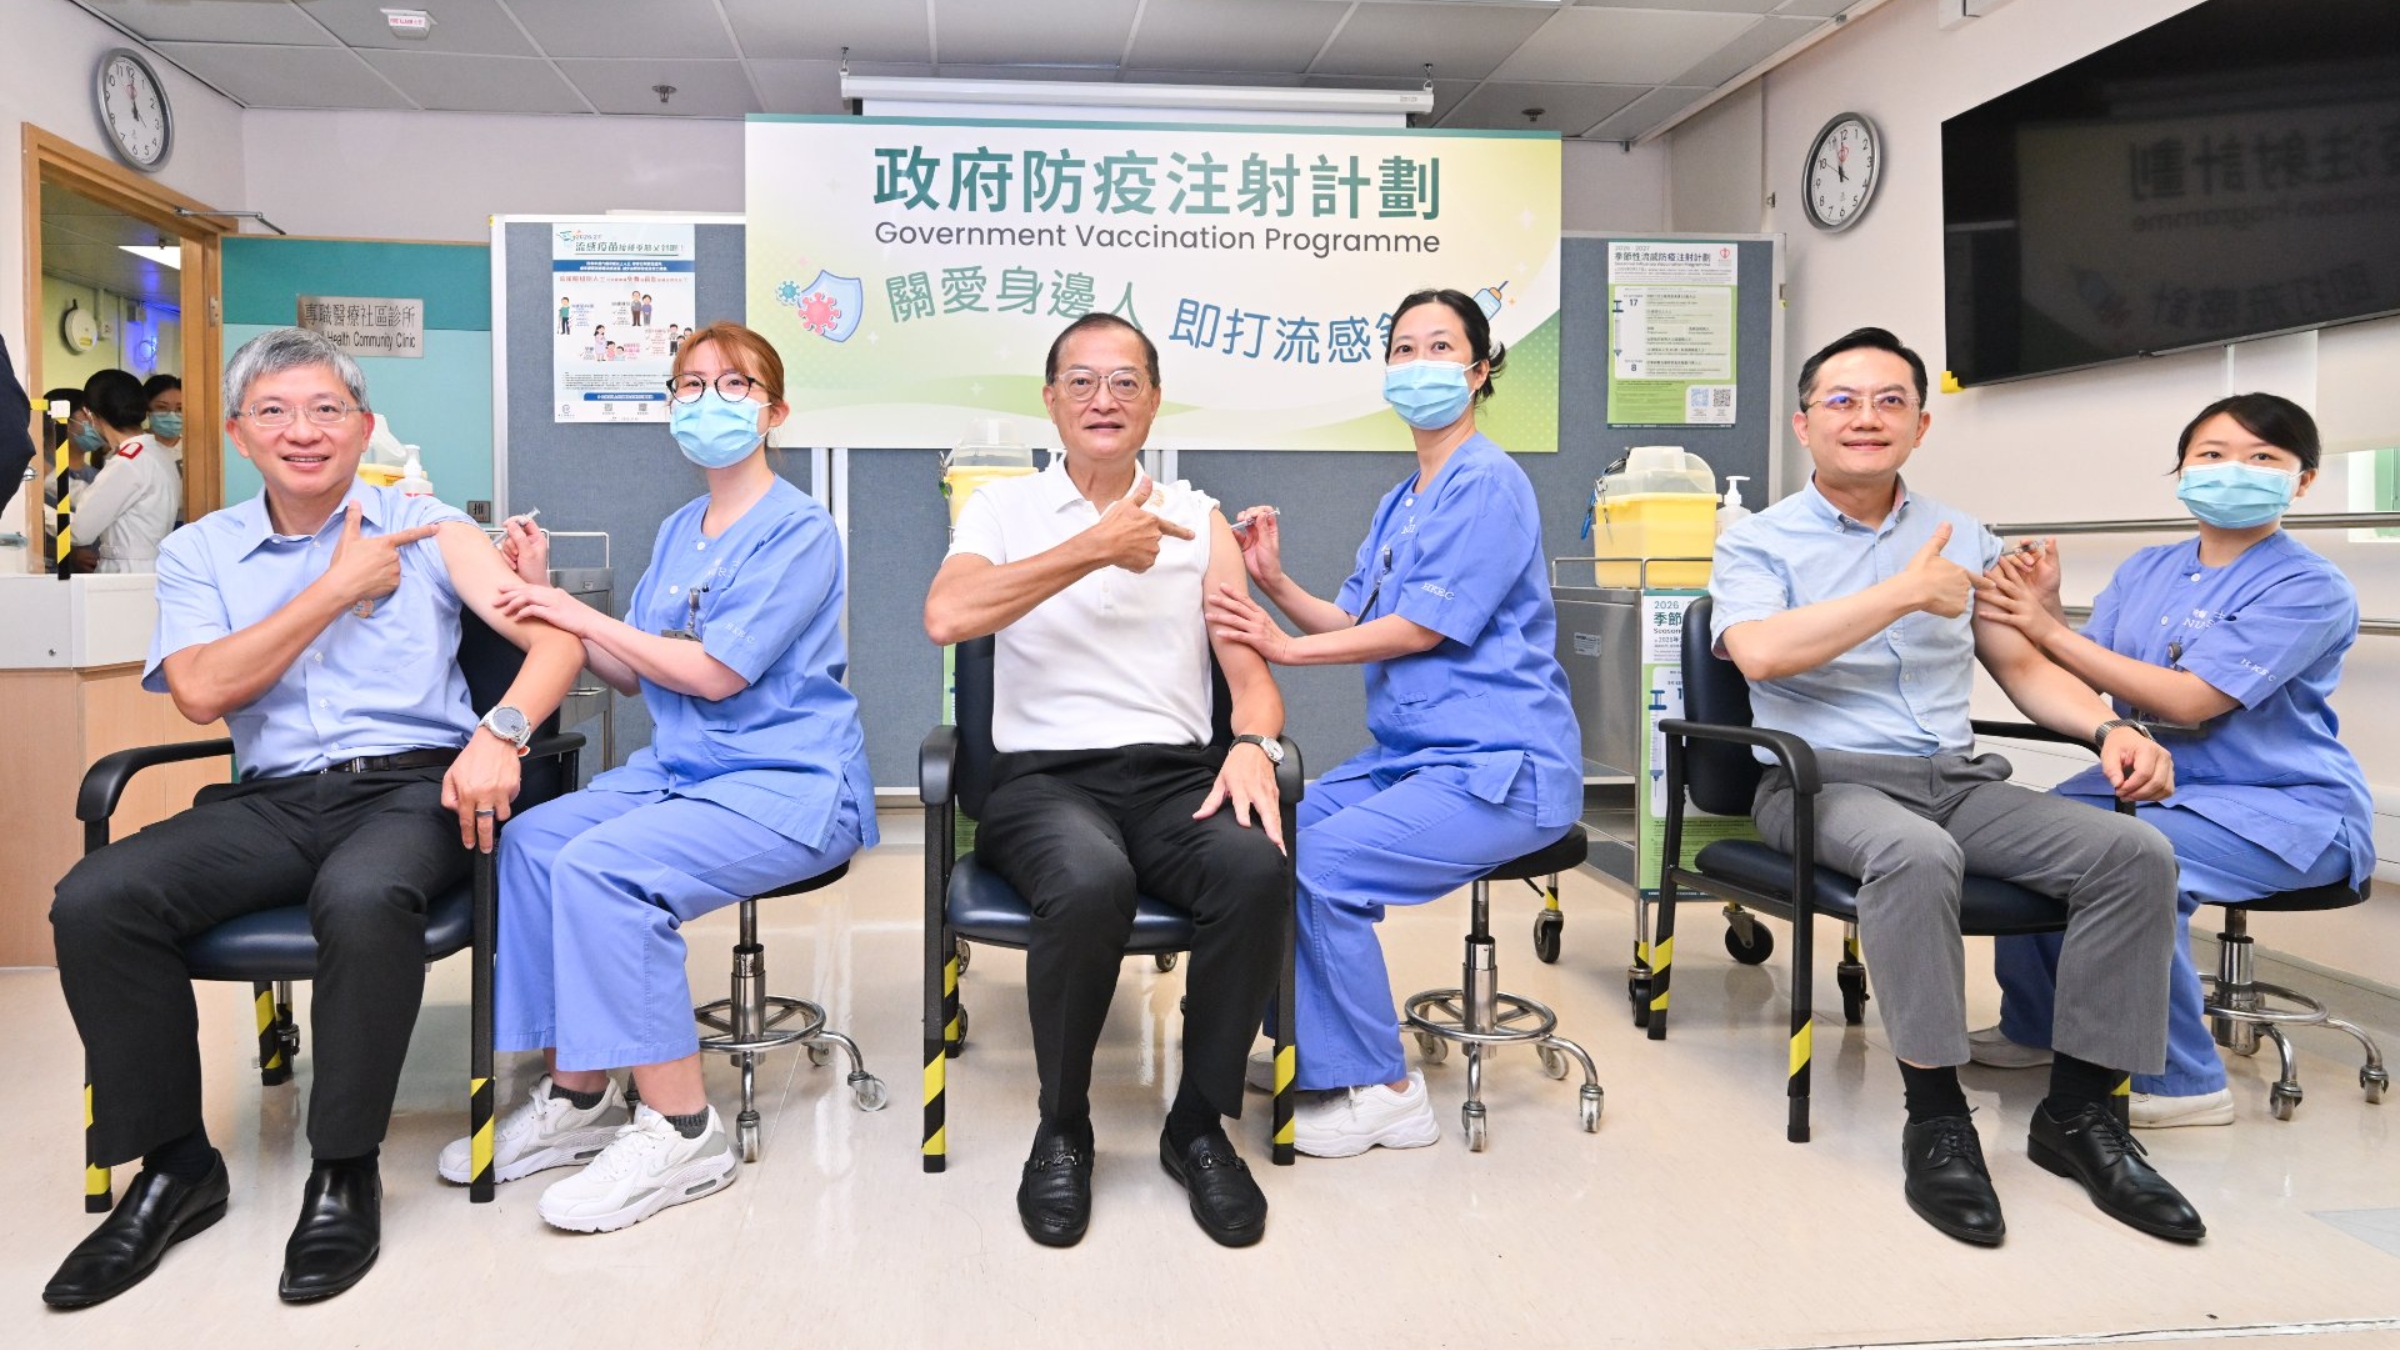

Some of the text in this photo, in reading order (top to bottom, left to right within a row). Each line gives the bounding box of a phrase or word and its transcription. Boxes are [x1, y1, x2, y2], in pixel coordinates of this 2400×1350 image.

[149, 98, 155, 110] 2
[154, 118, 160, 130] 3
[119, 132, 126, 141] 7
[1840, 129, 1848, 140] 12
[1854, 129, 1859, 140] 1
[152, 137, 157, 147] 4
[1863, 138, 1869, 151] 2
[132, 144, 138, 156] 6
[144, 145, 150, 156] 5
[1866, 155, 1873, 168] 3
[873, 145, 1440, 220] 政府防疫注射計劃
[1815, 178, 1821, 190] 9
[1862, 179, 1868, 188] 4
[1819, 195, 1825, 207] 8
[1852, 195, 1858, 207] 5
[1828, 205, 1834, 218] 7
[1839, 205, 1846, 217] 6
[875, 221, 1441, 259] Government Vaccination Programme
[885, 265, 1144, 331] 關愛身邊人
[305, 303, 416, 328] 專職醫療社區診所
[353, 331, 393, 351] Community
[396, 331, 416, 348] Clinic
[1654, 600, 1680, 609] 2026
[1654, 611, 1682, 626] 季節
